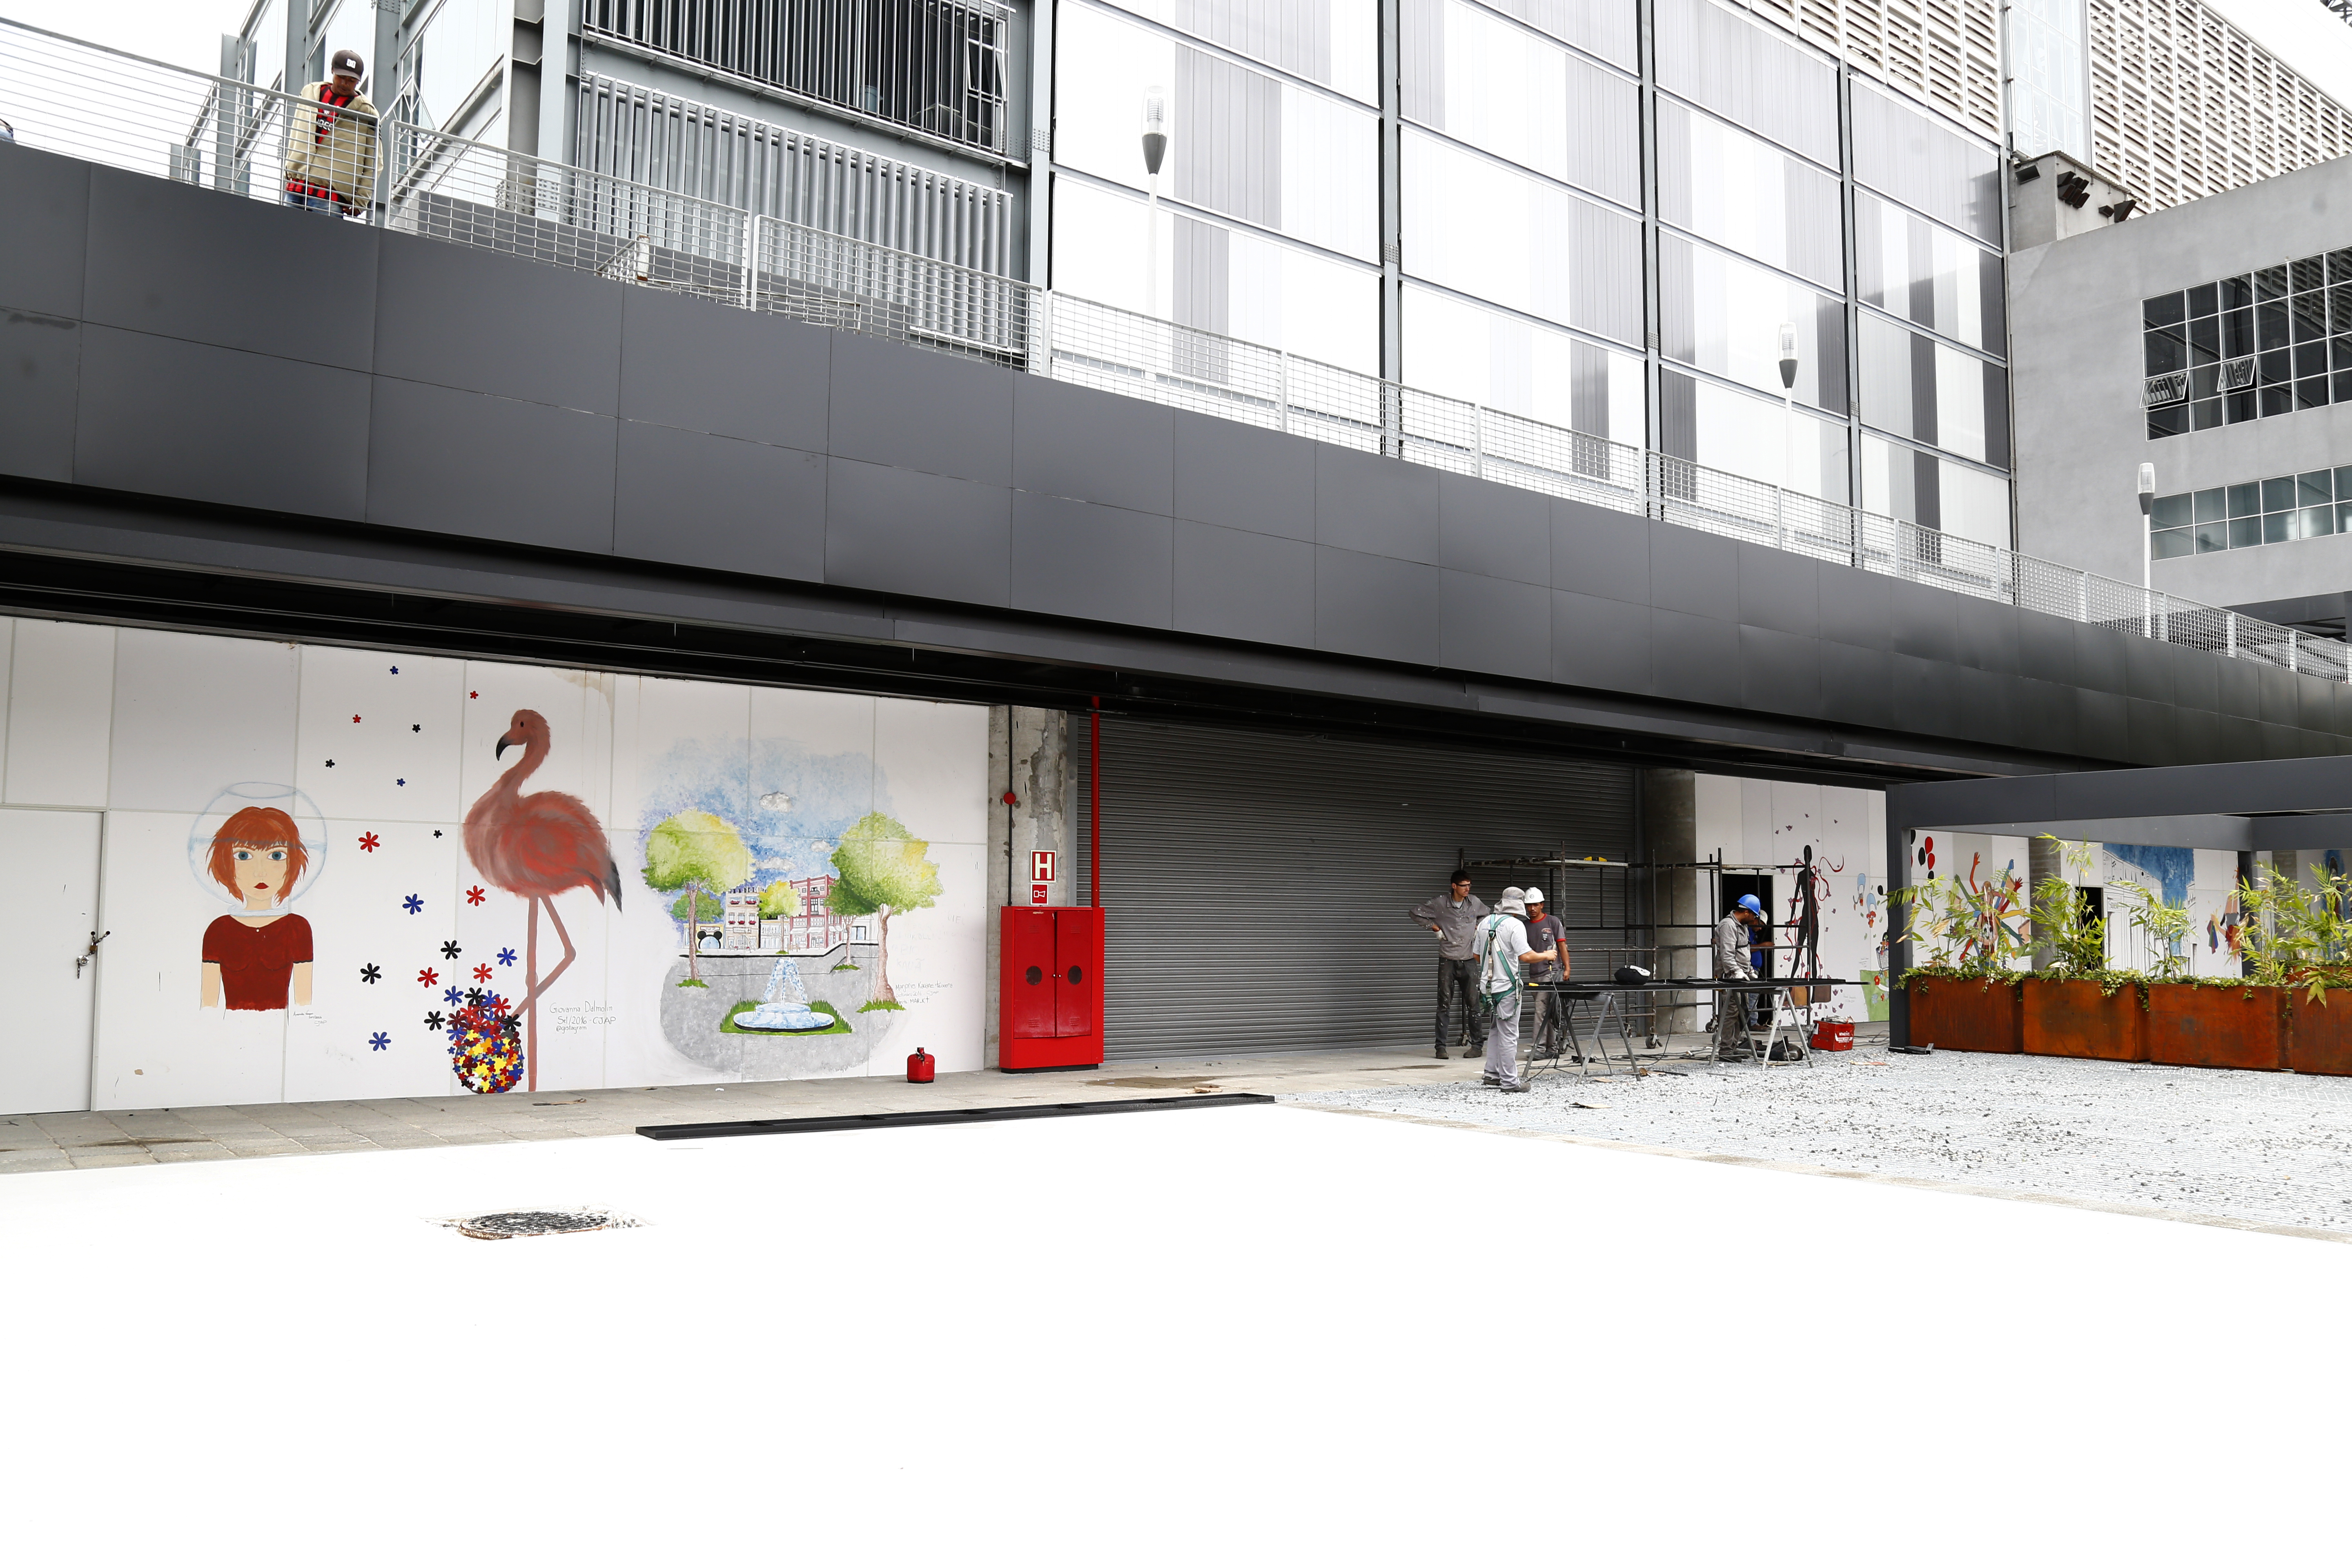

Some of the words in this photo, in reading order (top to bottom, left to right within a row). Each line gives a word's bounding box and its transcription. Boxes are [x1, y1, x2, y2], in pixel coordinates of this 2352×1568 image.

[1035, 853, 1052, 879] H
[550, 1002, 581, 1013] Giovanna
[585, 1000, 612, 1013] Dalmolin
[592, 1016, 616, 1025] CJAP
[556, 1025, 587, 1034] @gistagram
